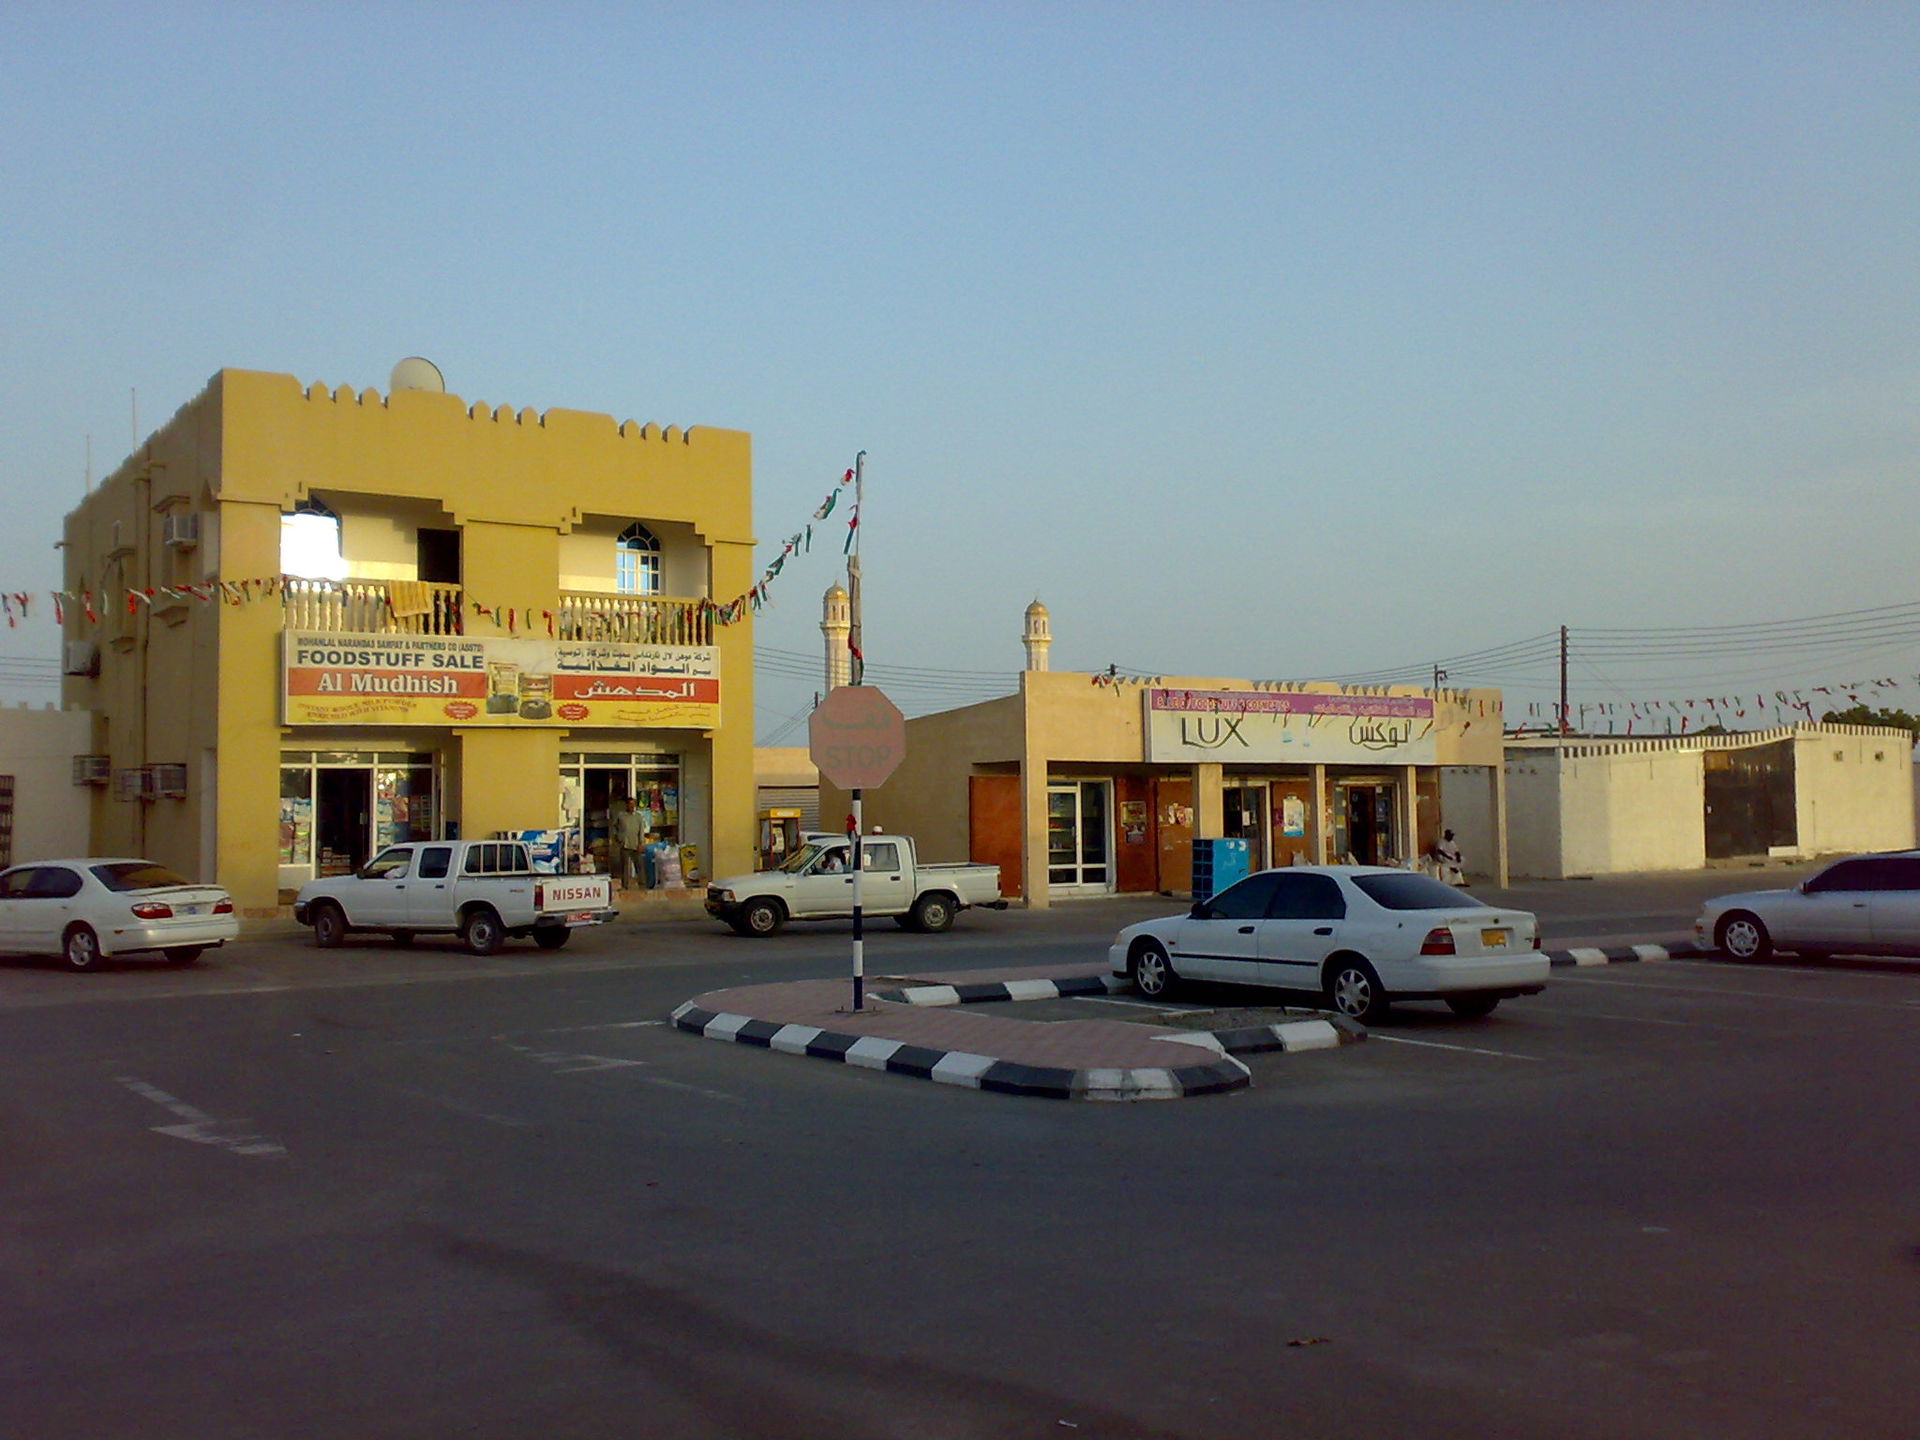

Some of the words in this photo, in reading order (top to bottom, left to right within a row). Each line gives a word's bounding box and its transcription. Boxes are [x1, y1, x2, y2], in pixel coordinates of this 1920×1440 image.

[411, 641, 446, 651] PARTNERS
[297, 649, 426, 668] FOODSTUFF
[432, 653, 485, 669] SALE
[639, 661, 690, 676] المواد
[317, 672, 342, 692] Al
[351, 673, 459, 694] Mudhish
[574, 679, 696, 699] المدهش
[1181, 717, 1250, 749] LUX
[823, 743, 891, 769] STOP
[552, 886, 601, 901] NISSAN
